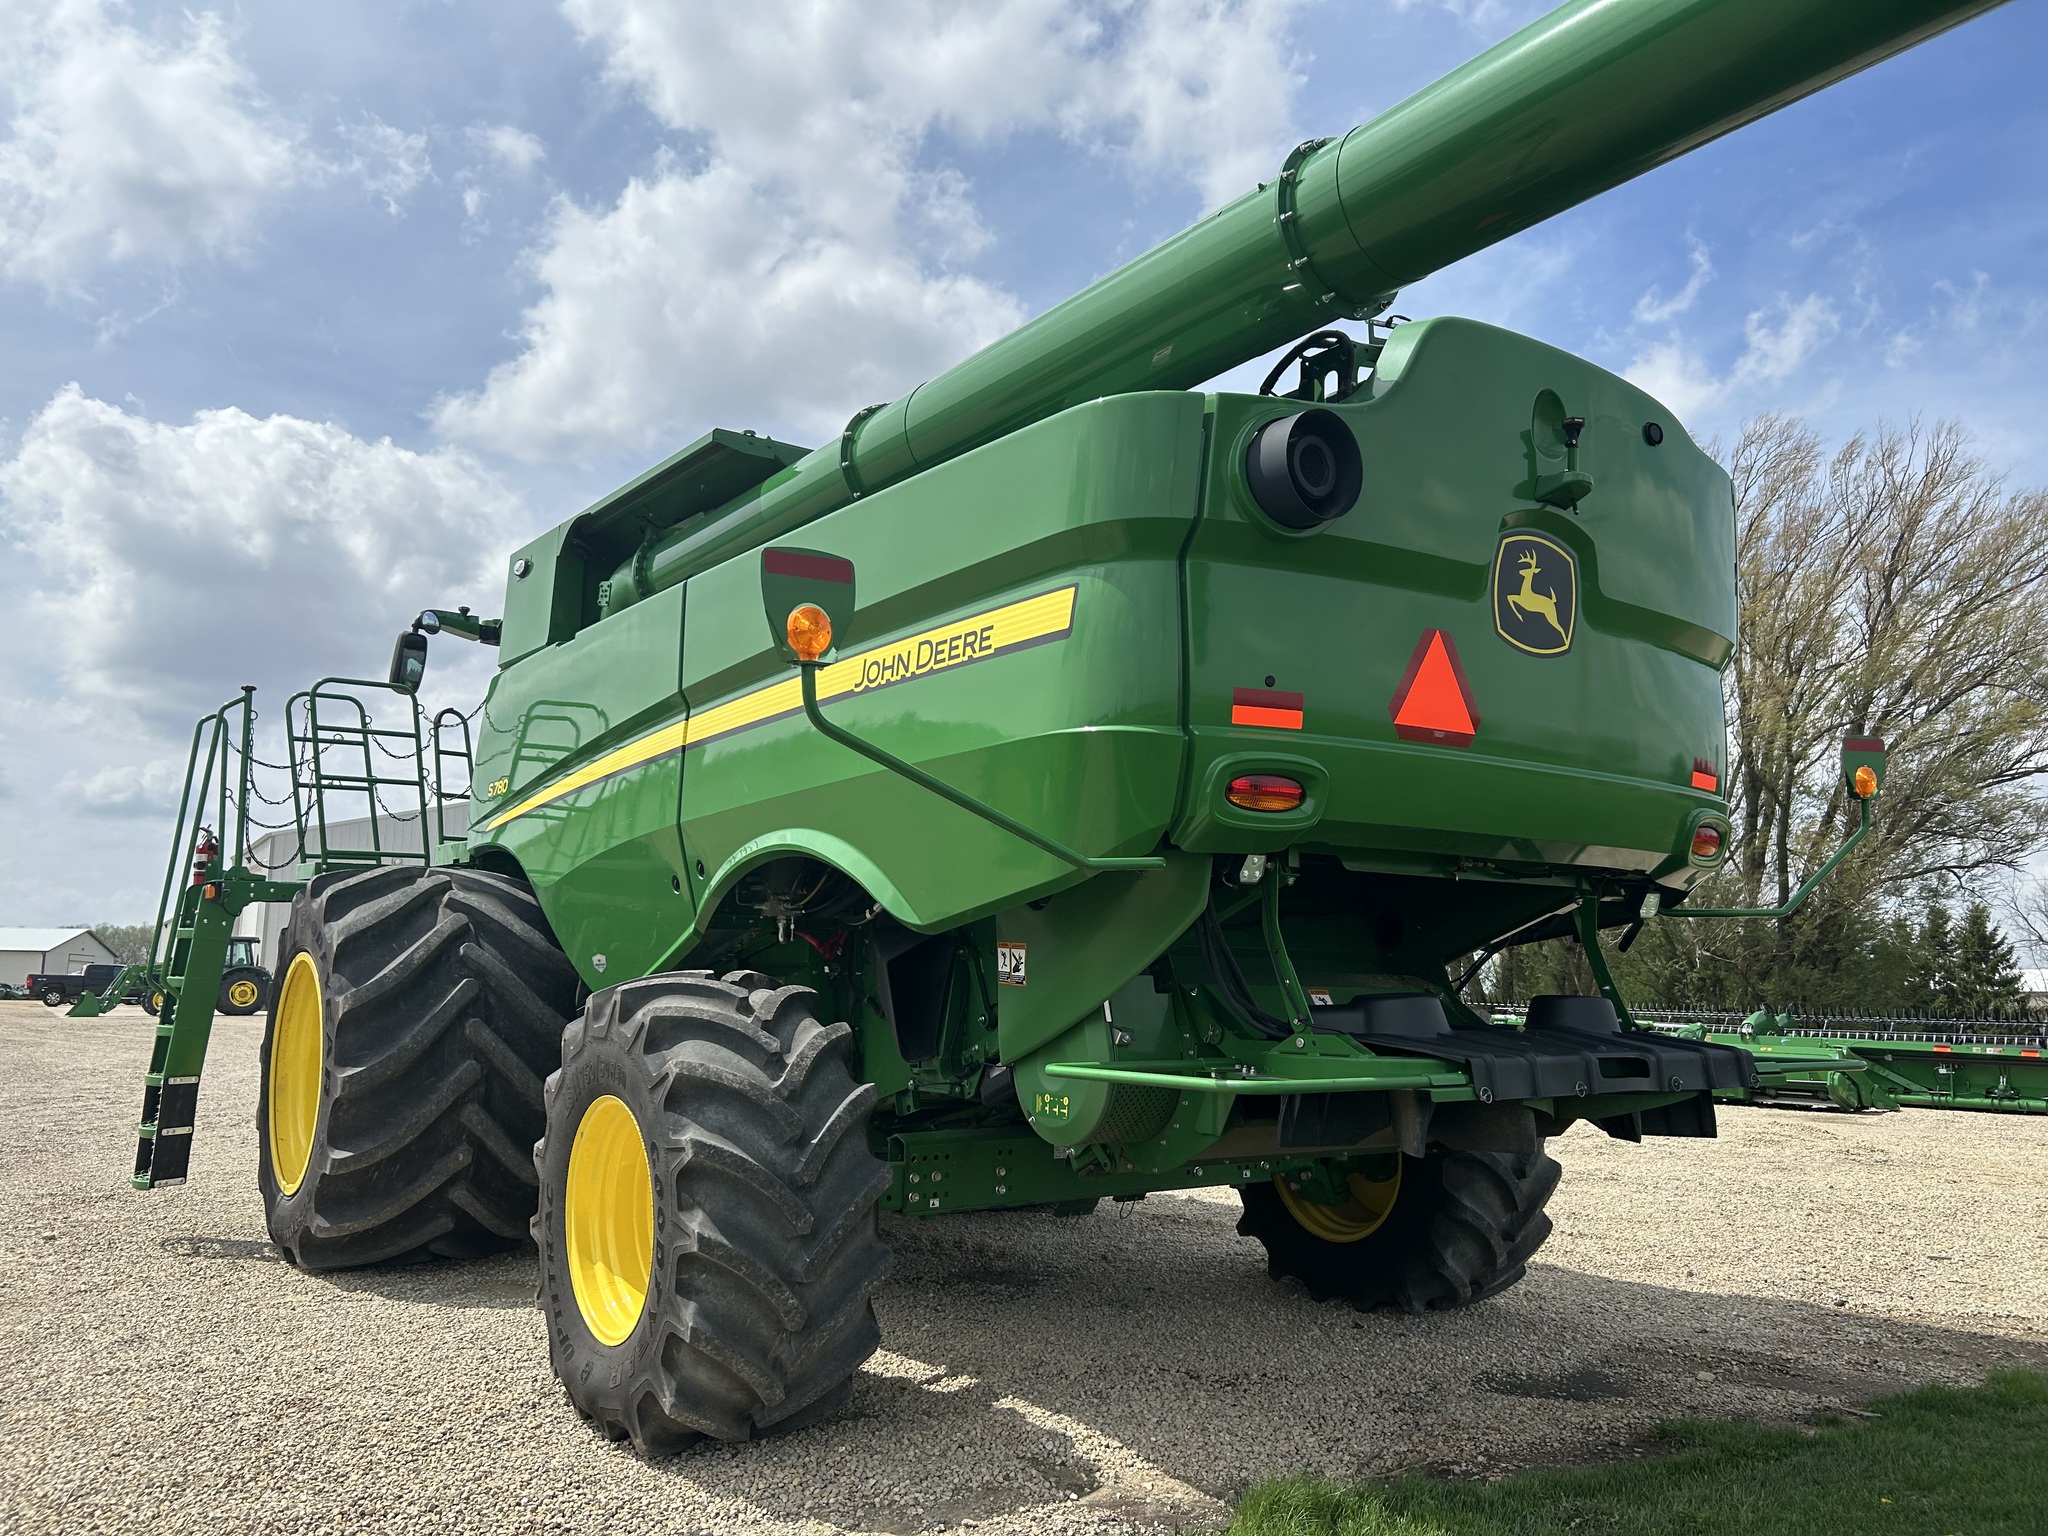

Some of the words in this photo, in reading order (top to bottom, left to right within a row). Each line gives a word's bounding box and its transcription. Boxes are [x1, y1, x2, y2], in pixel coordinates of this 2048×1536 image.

[854, 650, 911, 688] JOHN
[916, 625, 994, 670] DEERE
[487, 778, 509, 798] S780
